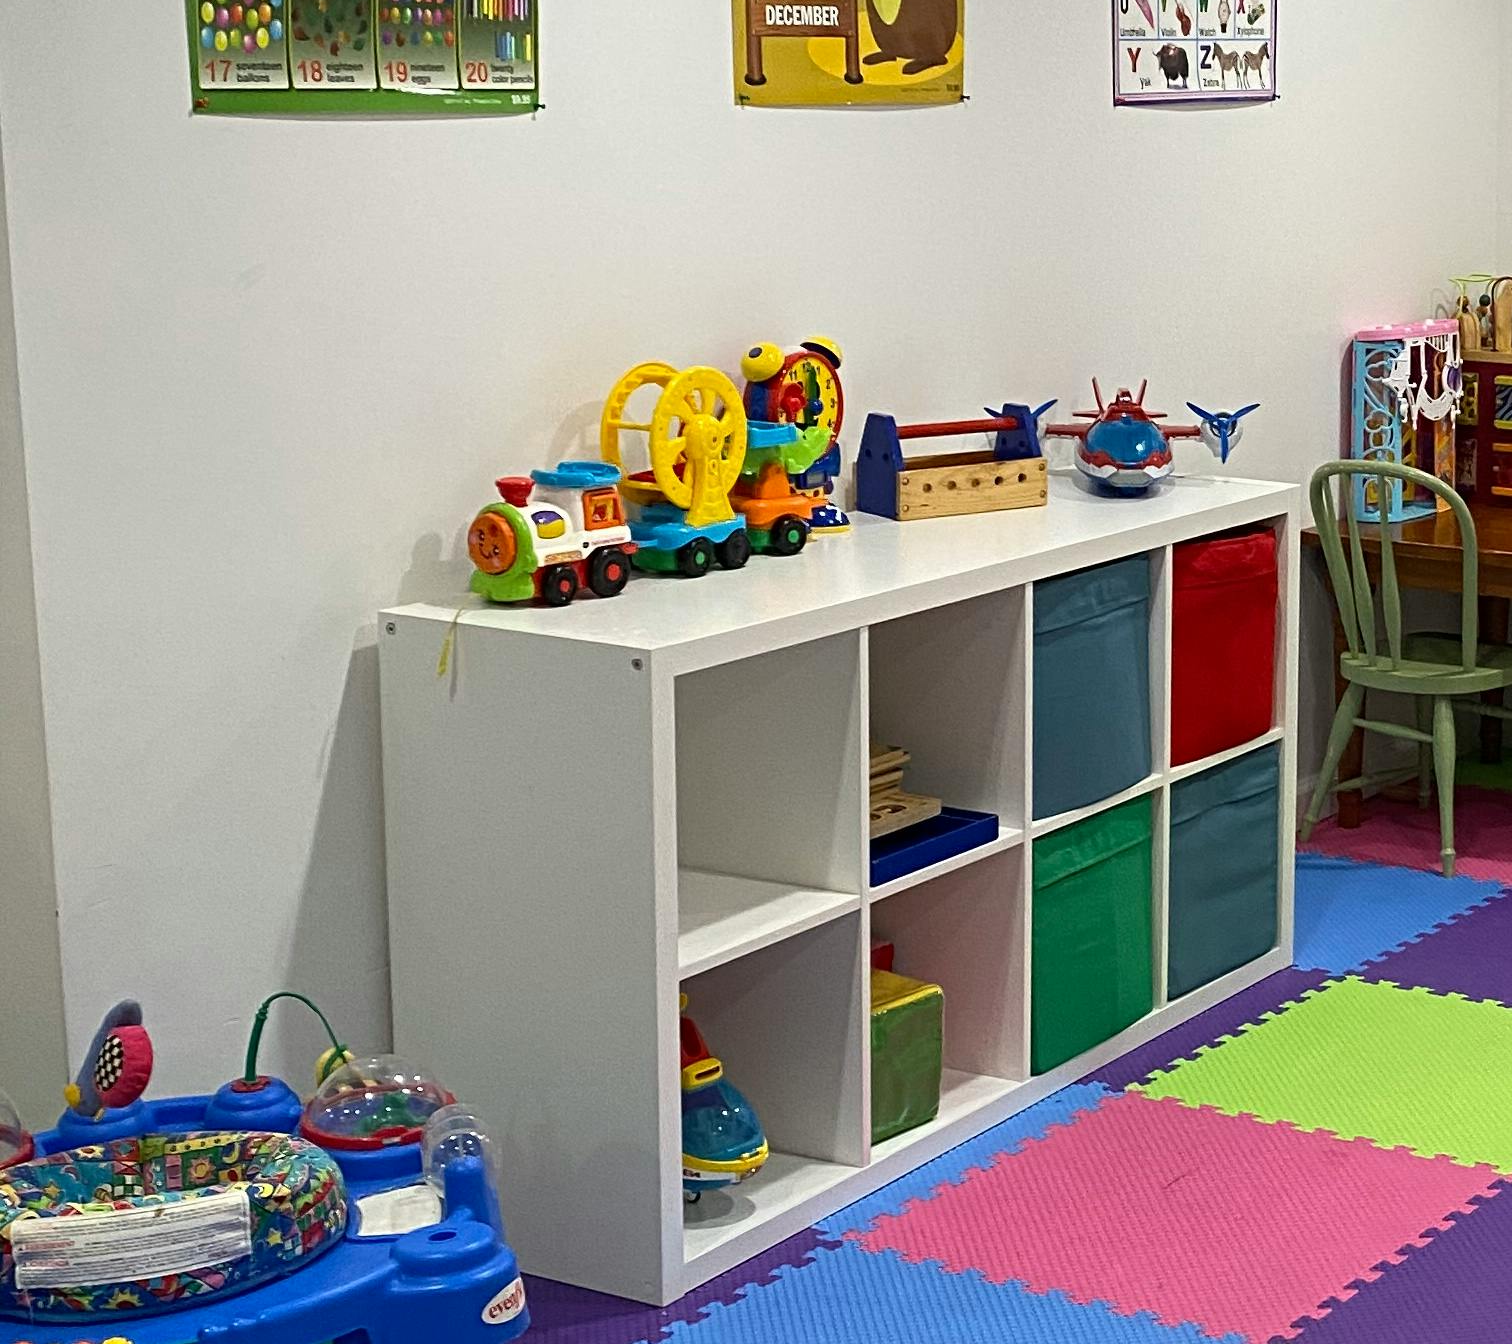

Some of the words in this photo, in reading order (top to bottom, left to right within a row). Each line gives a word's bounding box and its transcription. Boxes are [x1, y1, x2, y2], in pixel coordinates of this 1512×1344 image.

[765, 4, 839, 27] DECEMBER
[235, 62, 283, 71] seventeen
[1127, 47, 1142, 72] Y
[1200, 45, 1212, 69] Z
[205, 59, 232, 82] 17
[298, 60, 323, 83] 18
[327, 73, 355, 83] leaves
[384, 61, 408, 83] 19
[412, 75, 431, 85] eggs
[466, 61, 488, 83] 20
[492, 75, 509, 84] color
[510, 74, 533, 84] pencils
[789, 369, 797, 381] 11
[802, 362, 811, 373] 12
